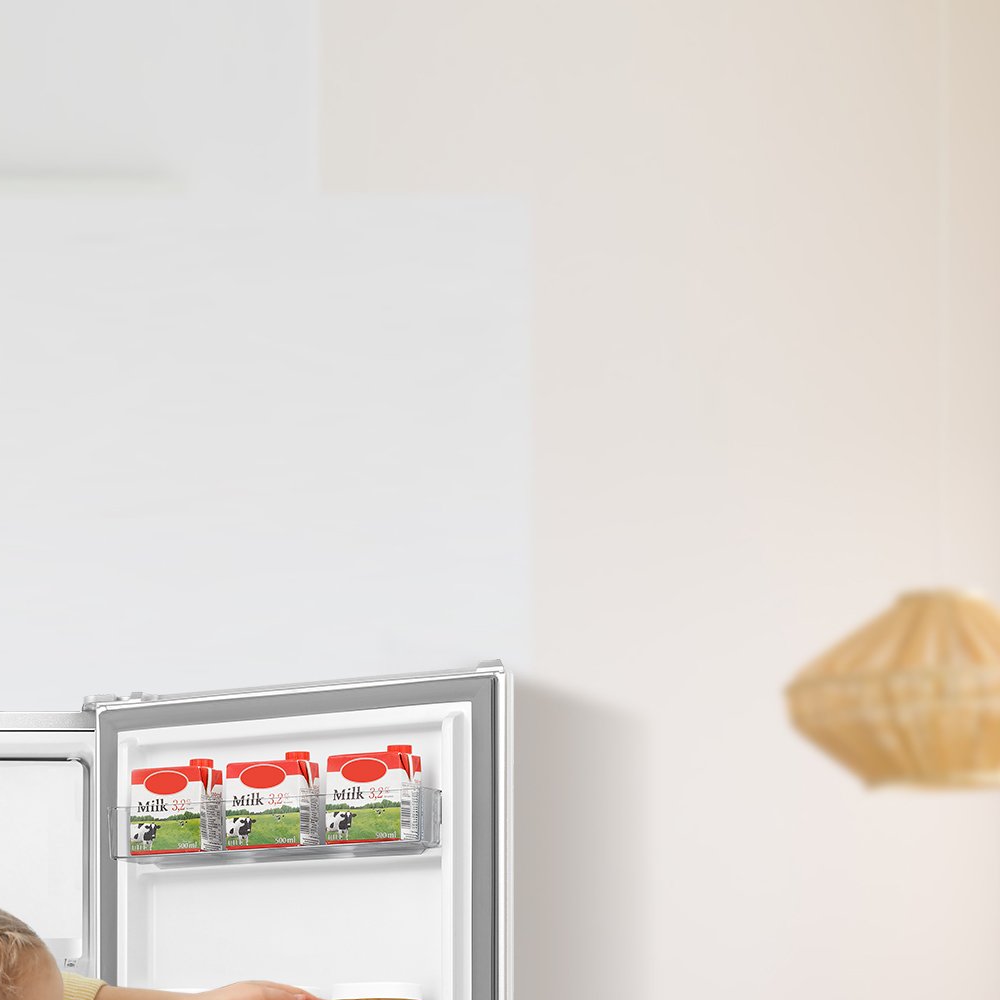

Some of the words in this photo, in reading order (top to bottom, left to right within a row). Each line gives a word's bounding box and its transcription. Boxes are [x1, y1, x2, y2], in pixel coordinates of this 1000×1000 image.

[232, 792, 264, 807] Milk
[333, 786, 365, 800] Milk
[137, 798, 169, 813] Milk
